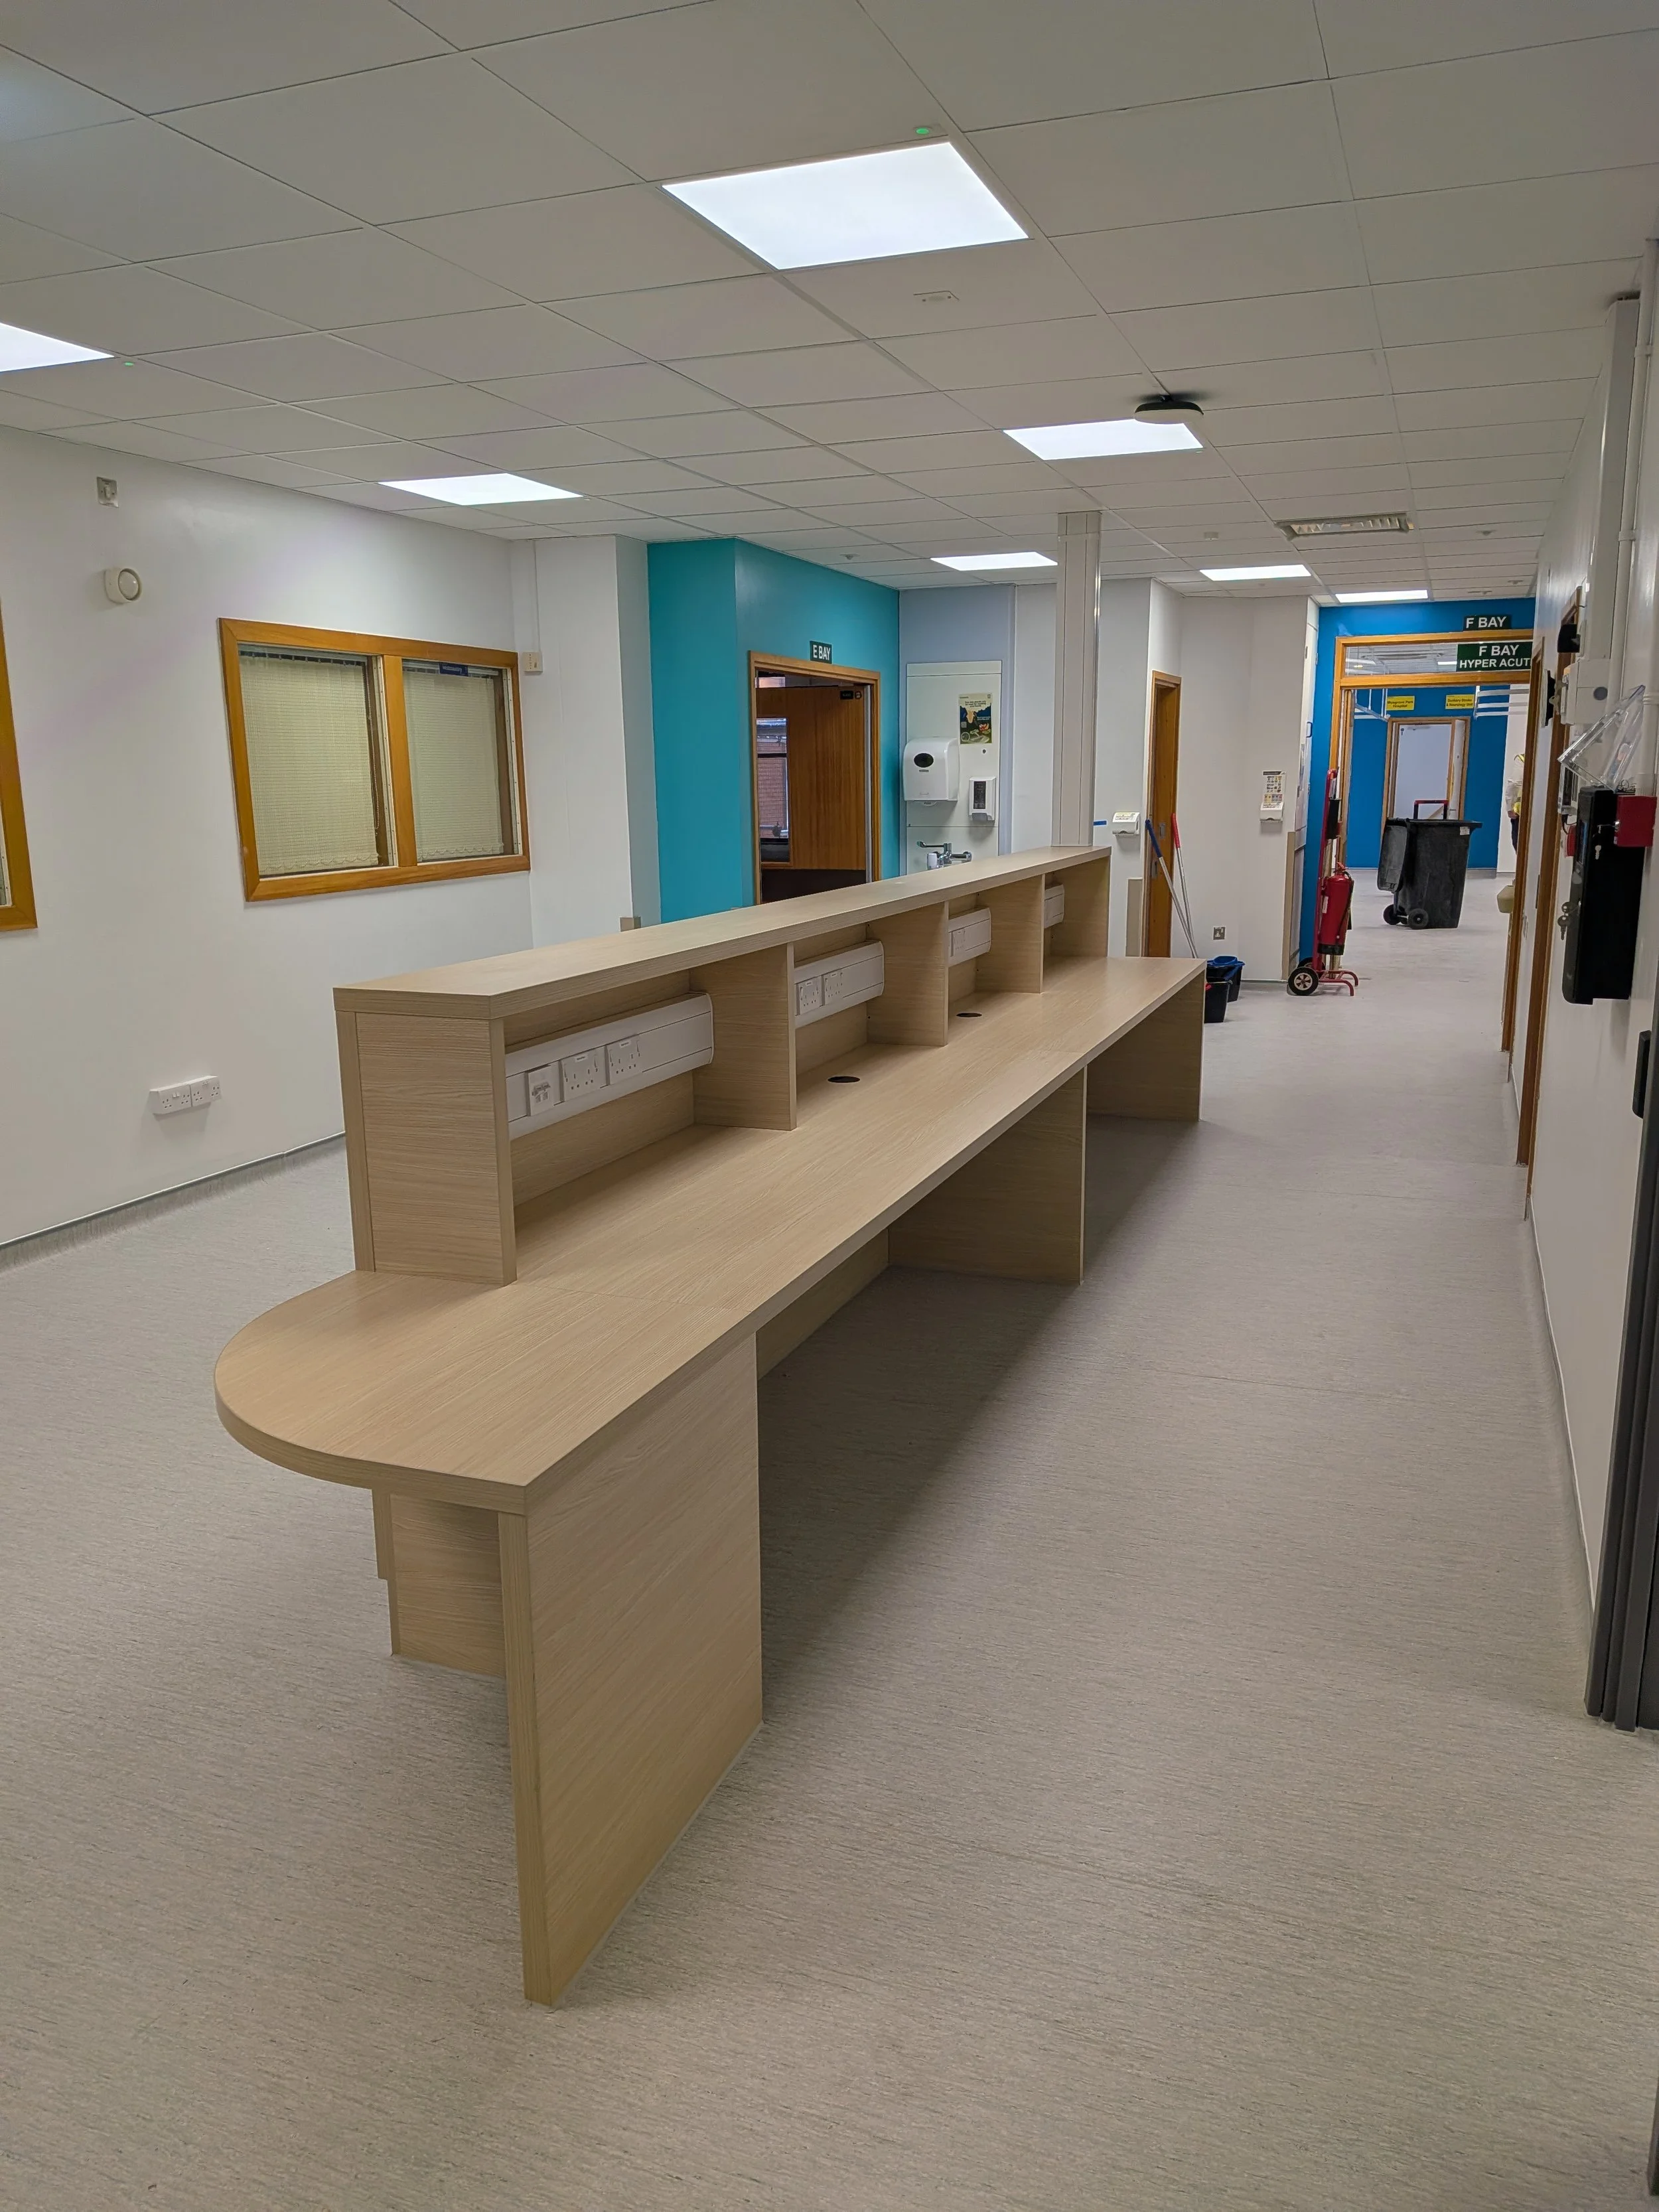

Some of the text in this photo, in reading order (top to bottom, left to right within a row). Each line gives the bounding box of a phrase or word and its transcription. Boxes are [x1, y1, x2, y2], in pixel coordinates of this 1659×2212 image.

[1466, 617, 1507, 628] F BAY
[813, 644, 831, 660] E BAY
[1479, 645, 1520, 656] F BAY
[1460, 658, 1532, 668] HYPER ACUT
